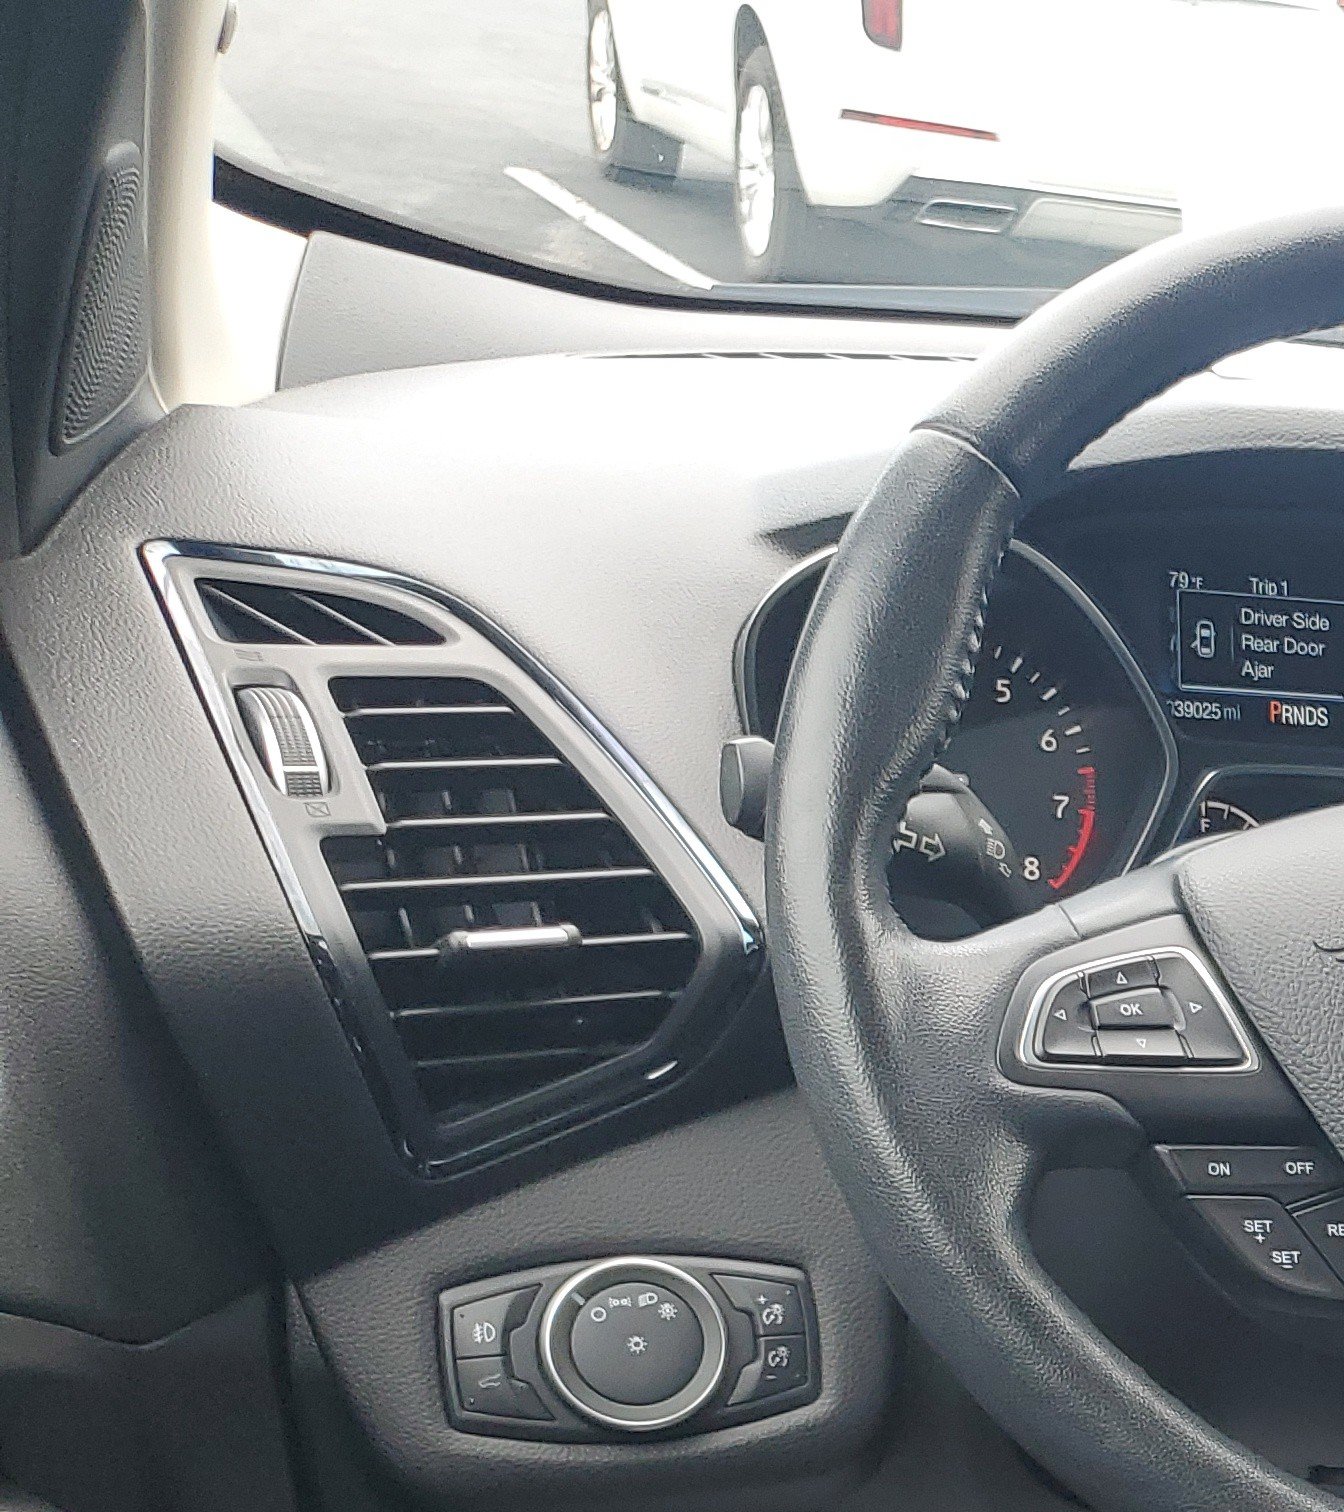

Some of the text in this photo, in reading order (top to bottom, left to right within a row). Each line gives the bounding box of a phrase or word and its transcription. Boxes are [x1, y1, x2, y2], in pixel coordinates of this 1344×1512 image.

[1248, 576, 1289, 597] Trip 1
[1240, 607, 1331, 632] Driver Side
[1241, 632, 1327, 657] Rear Door
[1240, 659, 1275, 681] Ajar
[996, 678, 1012, 704] 5
[1040, 727, 1058, 752] 6
[1052, 792, 1070, 820] 7
[1200, 817, 1212, 834] F
[1023, 855, 1041, 882] 8
[1119, 1002, 1144, 1017] OK
[1207, 1161, 1232, 1177] ON
[1284, 1160, 1316, 1176] OFF
[1243, 1219, 1273, 1234] SET
[1270, 1250, 1301, 1265] SET
